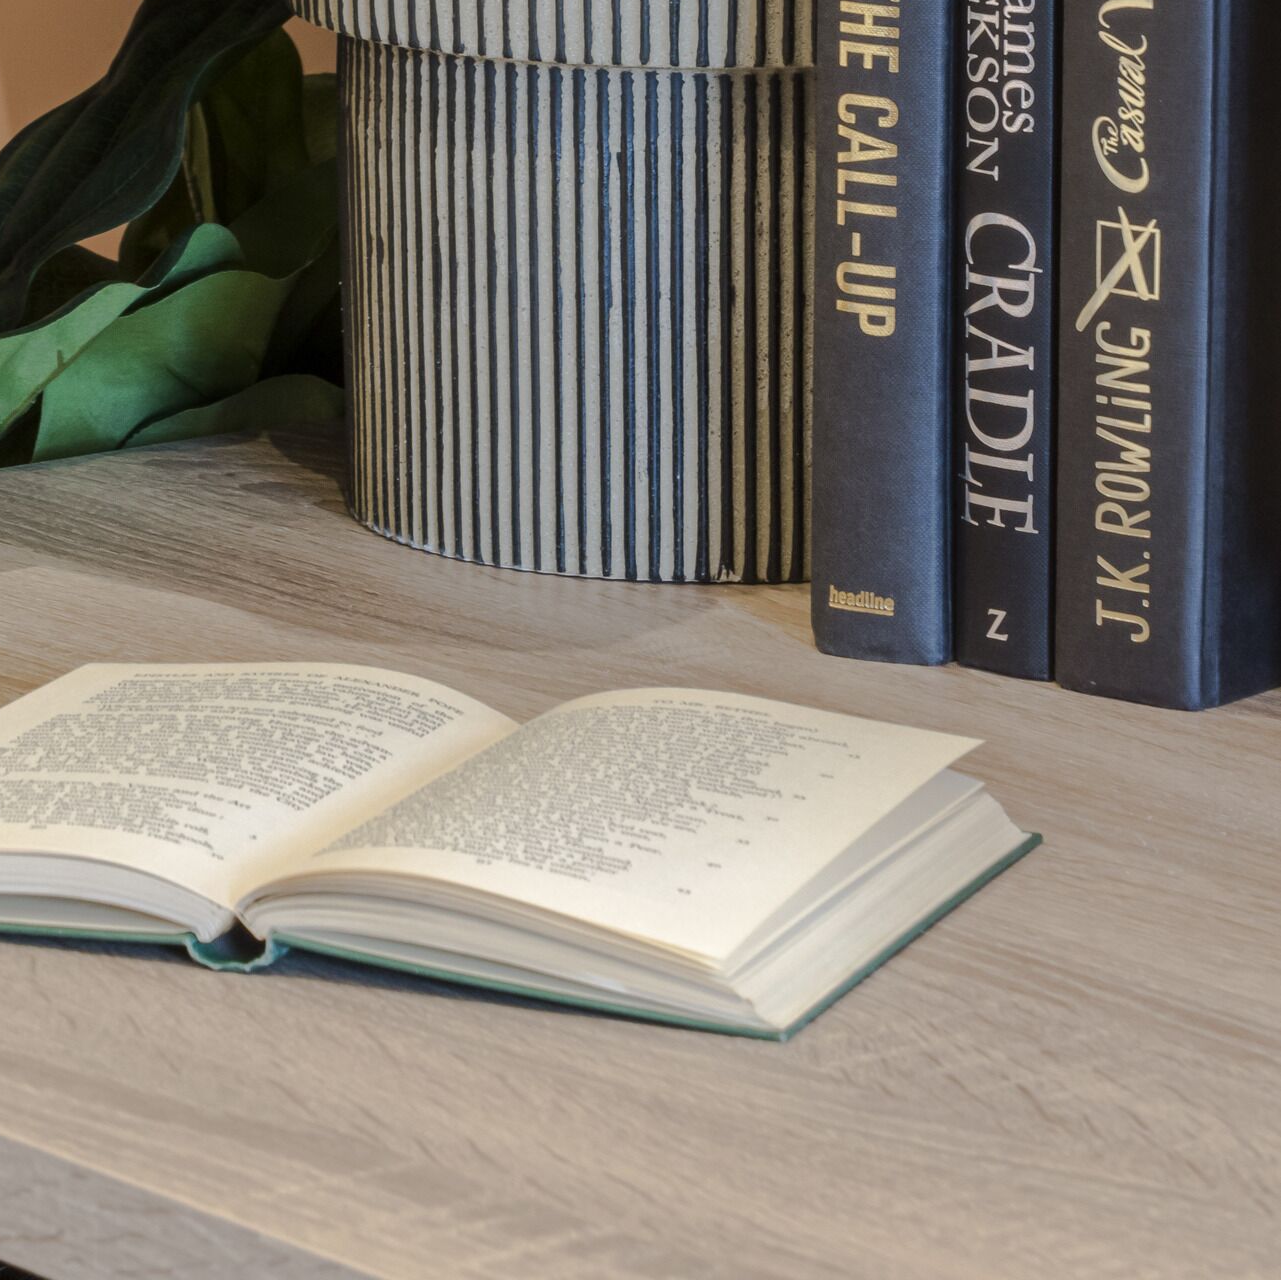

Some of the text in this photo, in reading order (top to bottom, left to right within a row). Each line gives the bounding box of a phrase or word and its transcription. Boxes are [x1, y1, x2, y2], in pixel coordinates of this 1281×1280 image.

[1091, 29, 1150, 194] Casual
[1100, 125, 1119, 156] The
[835, 93, 899, 337] CALL-UP
[959, 211, 1044, 535] CRADLE
[828, 584, 895, 617] headline
[1095, 551, 1151, 643] J.K.
